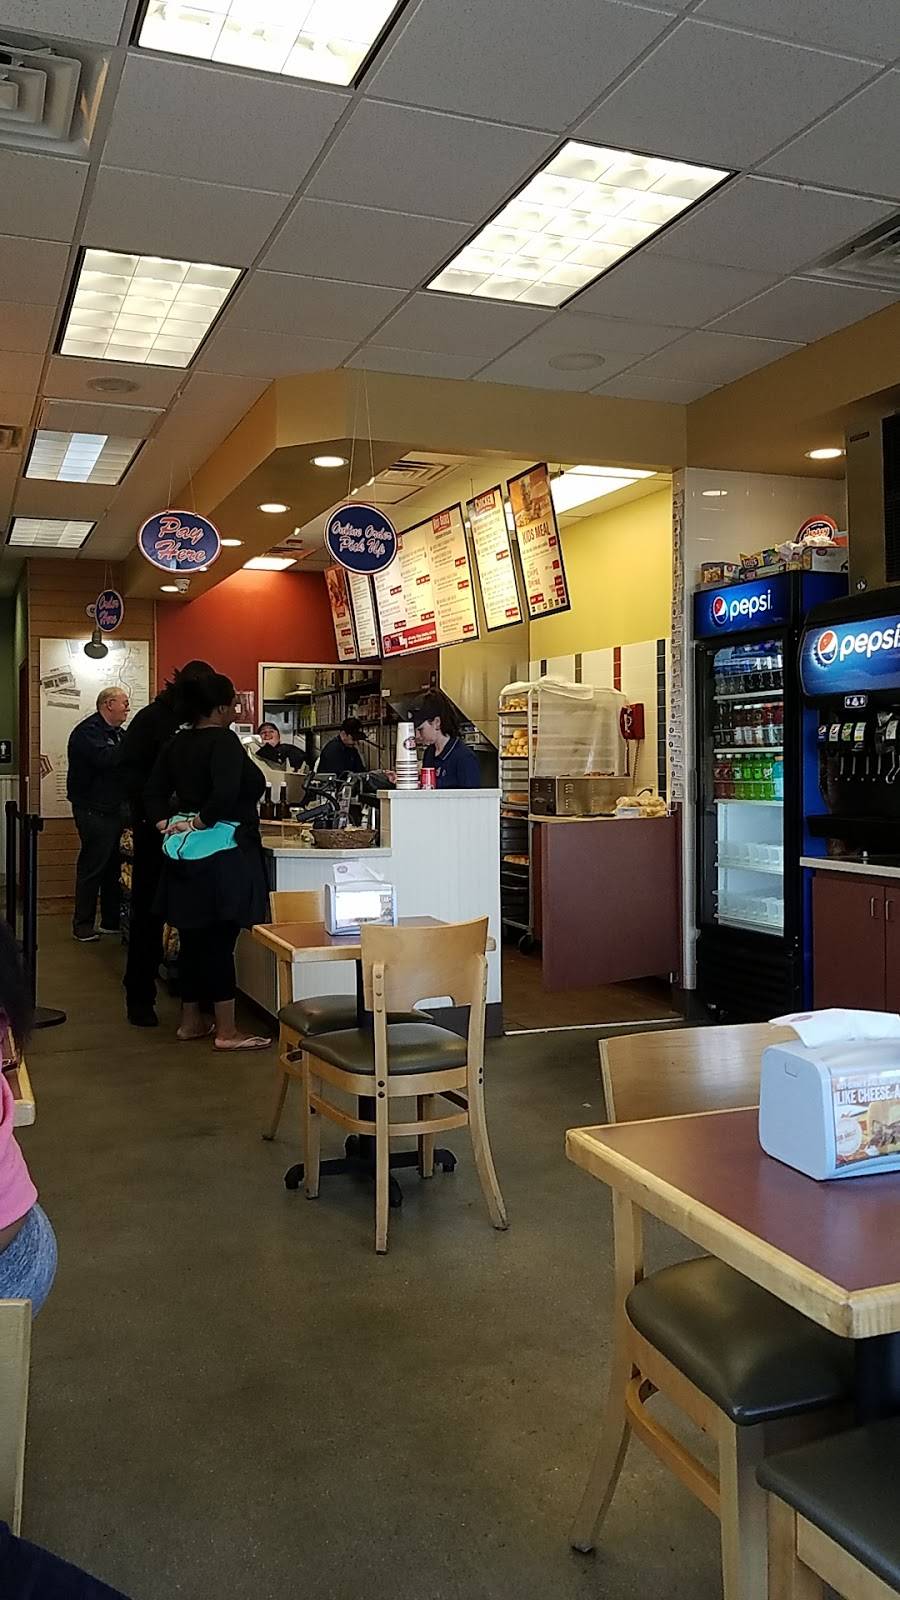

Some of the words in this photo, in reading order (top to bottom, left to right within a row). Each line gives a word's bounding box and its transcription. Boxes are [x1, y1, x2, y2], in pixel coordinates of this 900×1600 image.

[159, 517, 204, 545] Pay
[331, 520, 363, 538] Online
[364, 524, 393, 541] Order
[522, 528, 535, 545] KIDS
[535, 521, 550, 537] MEAL
[155, 540, 206, 563] Here
[339, 535, 366, 553] Pick
[366, 538, 386, 559] Up
[99, 596, 119, 609] Order
[729, 589, 771, 622] pepsi
[99, 611, 117, 625] Here
[839, 622, 900, 662] pepsi
[836, 1090, 857, 1104] LIKE
